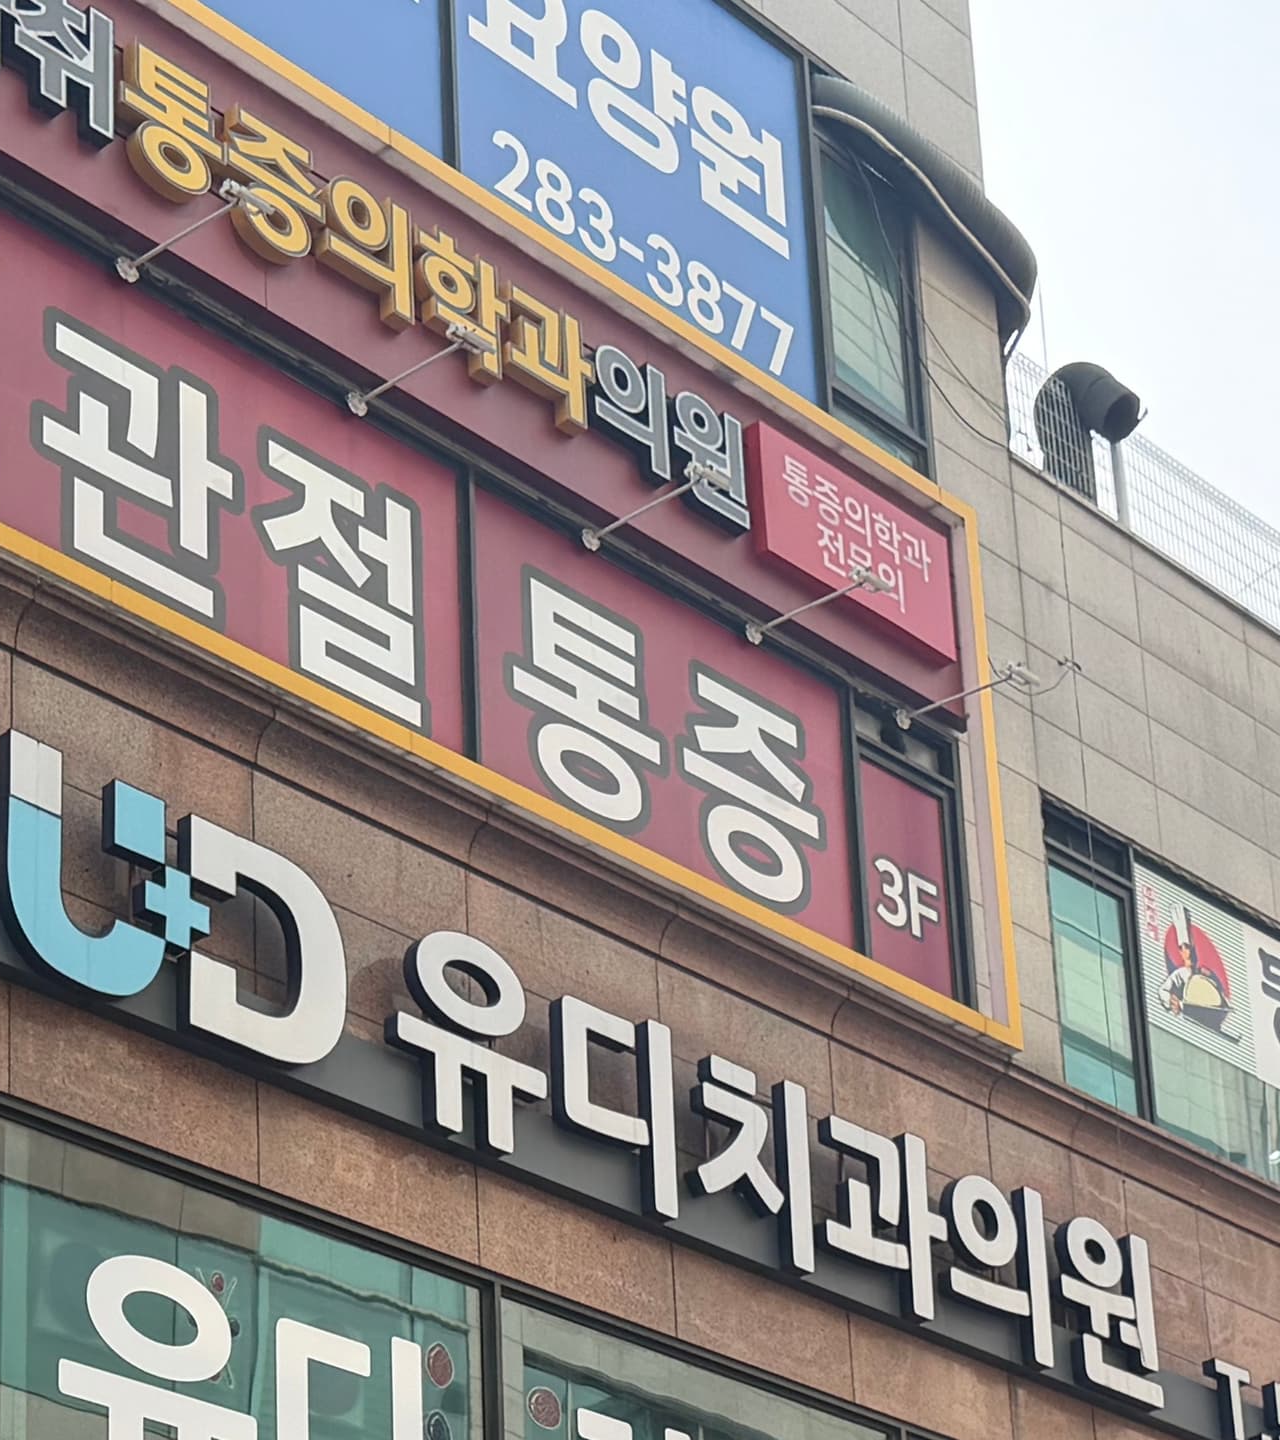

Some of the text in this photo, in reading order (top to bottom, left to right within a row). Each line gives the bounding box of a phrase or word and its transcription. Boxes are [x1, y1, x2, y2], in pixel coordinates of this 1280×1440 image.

[468, 0, 789, 259] 요양원
[491, 130, 794, 376] 283-3877
[41, 321, 424, 729] 관절
[512, 577, 820, 904] 통증
[782, 455, 932, 584] 통증의학과
[816, 522, 906, 614] 전문의
[873, 857, 939, 938] 3F
[394, 930, 1163, 1409] 유디치과의원
